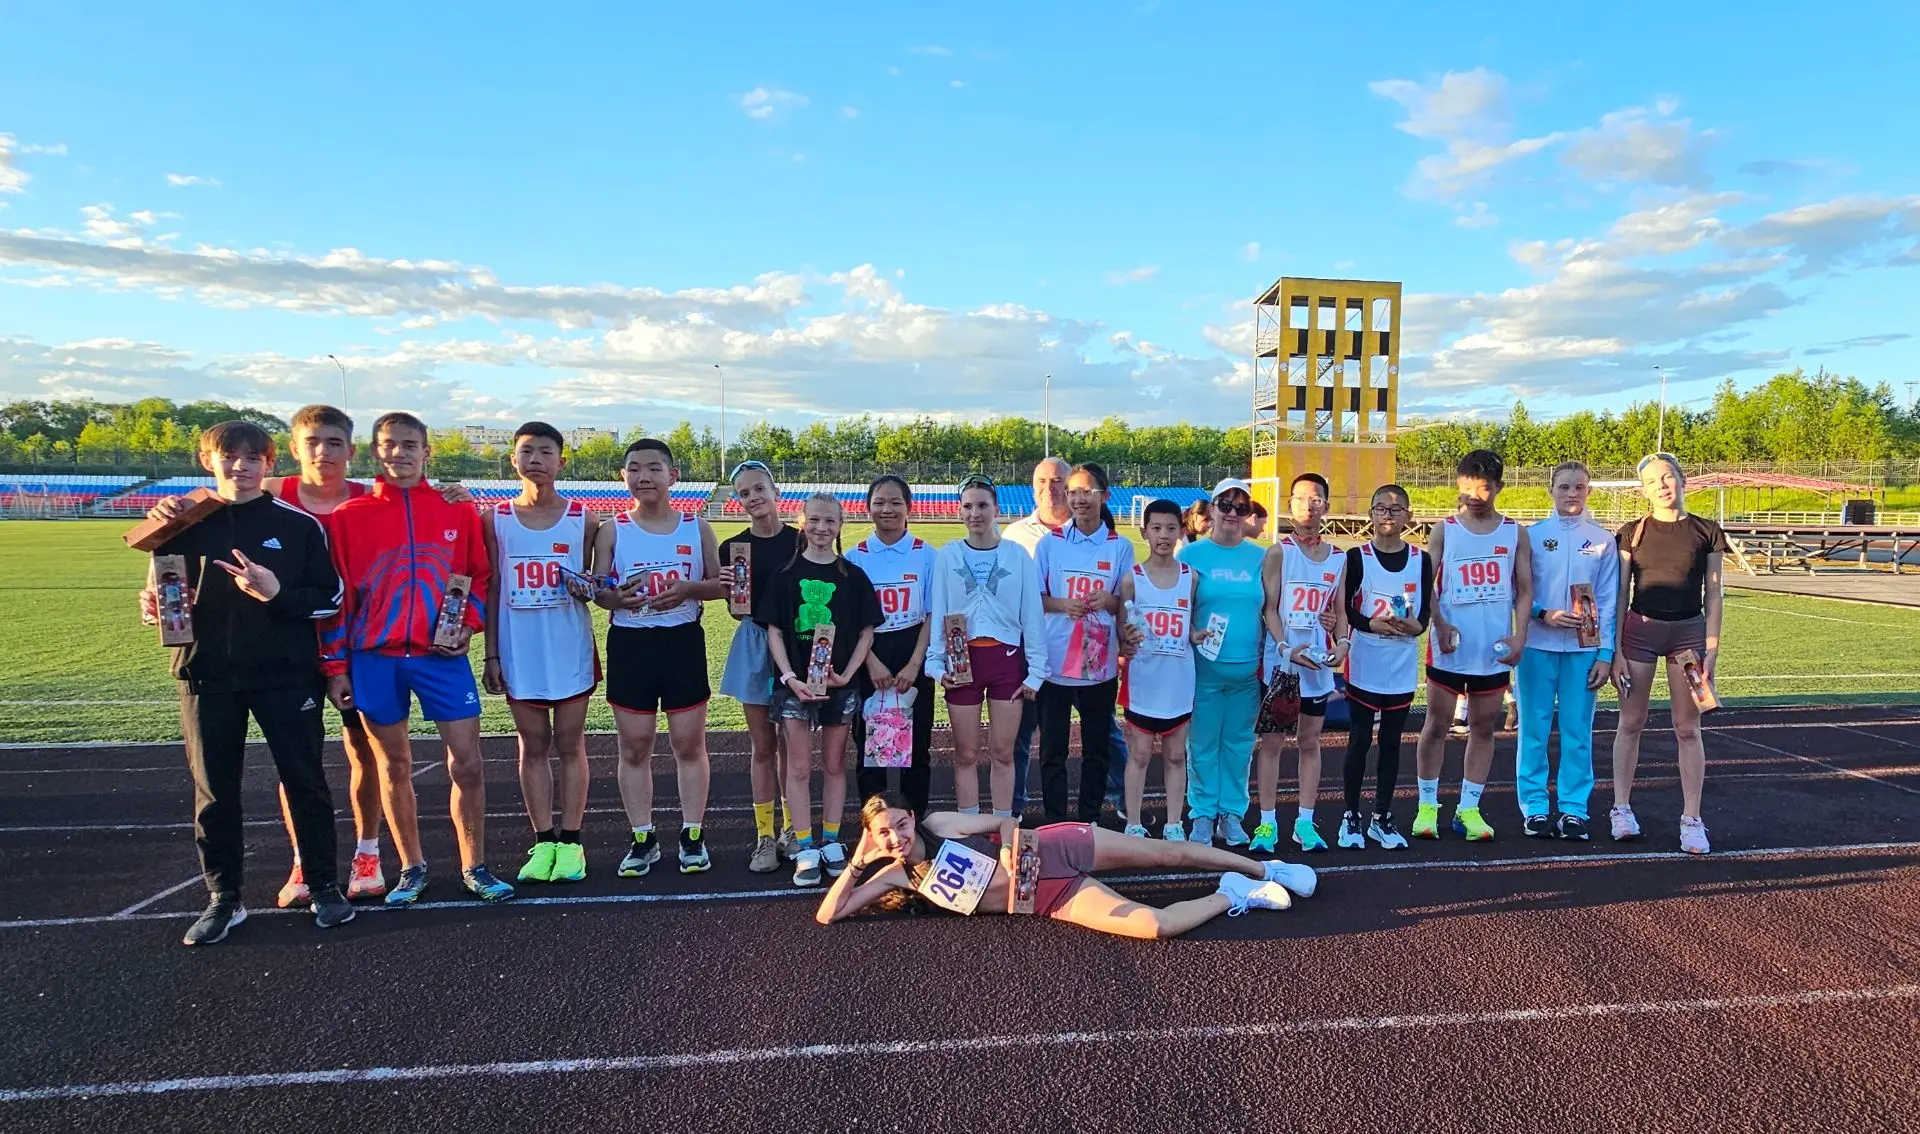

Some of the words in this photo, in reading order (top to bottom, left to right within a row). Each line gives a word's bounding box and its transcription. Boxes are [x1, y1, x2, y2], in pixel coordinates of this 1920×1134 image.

[513, 560, 561, 589] 196
[1211, 568, 1252, 582] FILA
[1457, 560, 1501, 587] 199
[929, 851, 974, 903] 264
